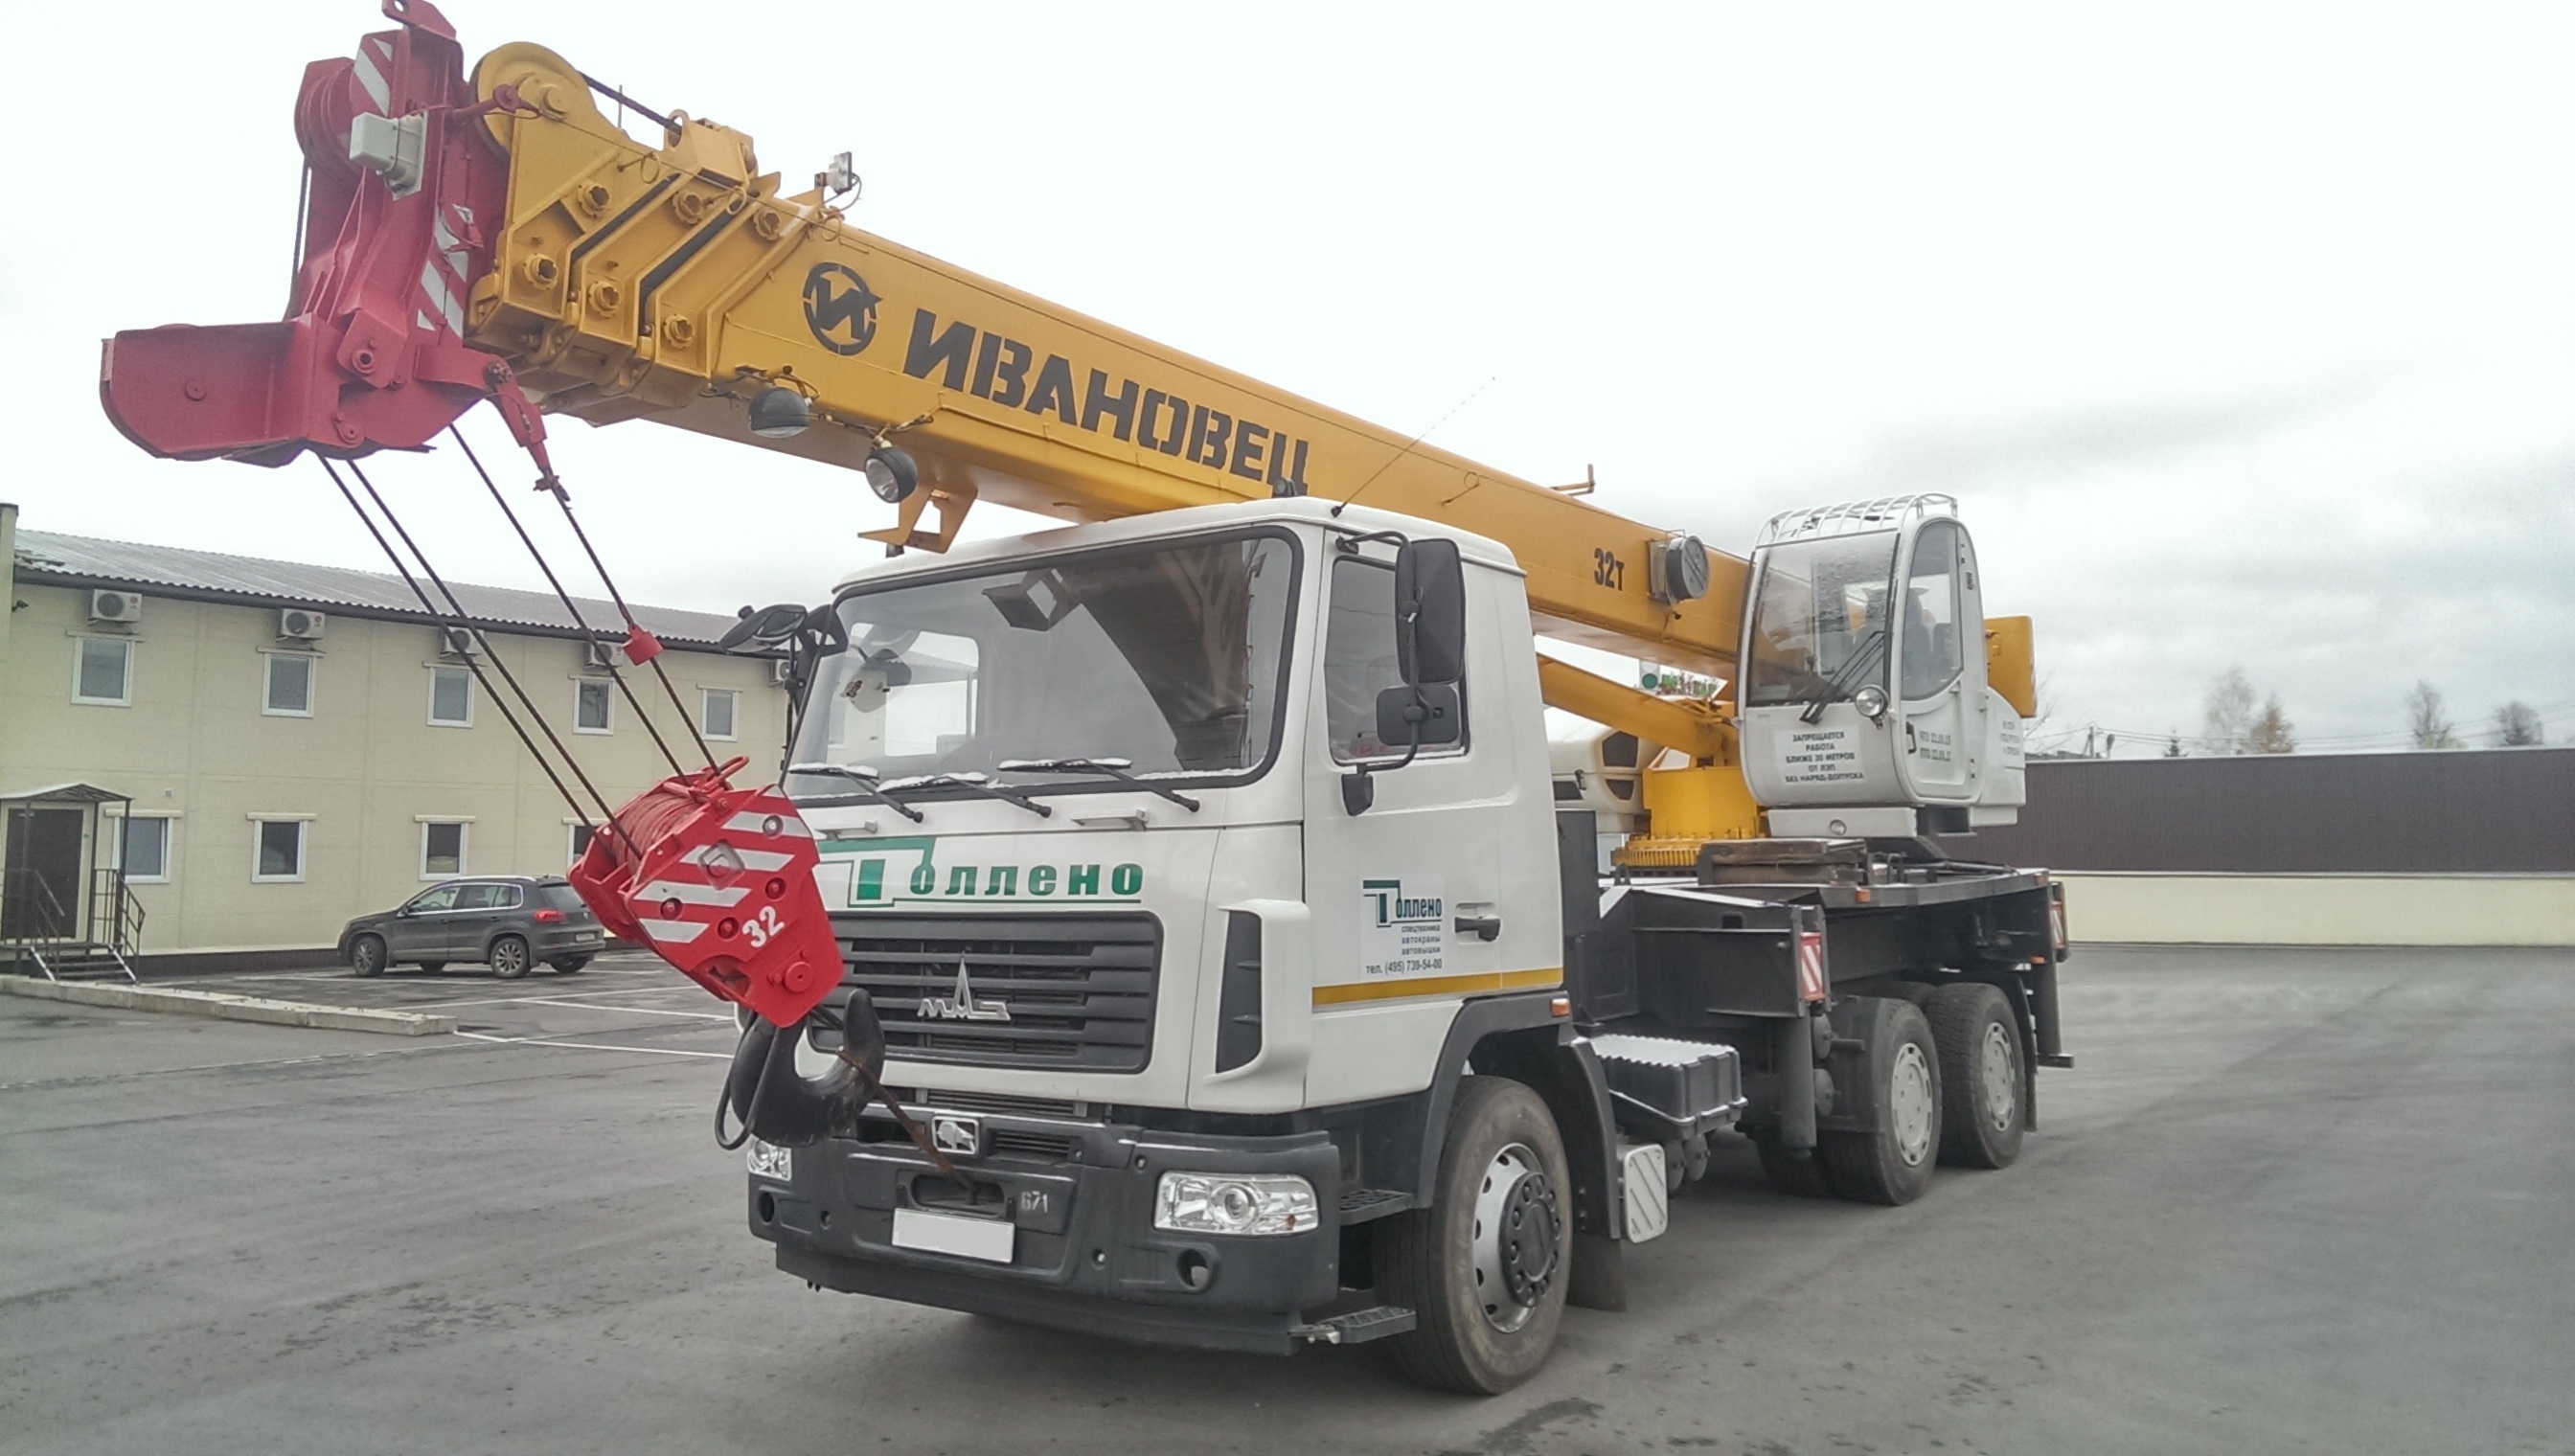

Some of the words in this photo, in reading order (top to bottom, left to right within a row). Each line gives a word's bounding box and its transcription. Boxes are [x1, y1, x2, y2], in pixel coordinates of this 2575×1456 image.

[902, 307, 1309, 496] ИВАНОВЕЦ
[1791, 731, 1845, 742] ЗАПРЕЩАЕТСЯ
[1805, 742, 1835, 752] РАБОТА
[1786, 754, 1812, 763] БЛИЖЕ
[1825, 752, 1856, 762] МЕТРОВ
[1808, 764, 1818, 773] ОТ
[1363, 880, 1442, 923] Толлено
[741, 905, 786, 948] 32
[1401, 925, 1441, 934] спецтехника
[1401, 936, 1441, 945] автокраны
[1401, 946, 1441, 955] автовышки
[1365, 964, 1382, 975] тел.
[1384, 960, 1405, 975] (495)
[1406, 959, 1442, 971] 739-54-00
